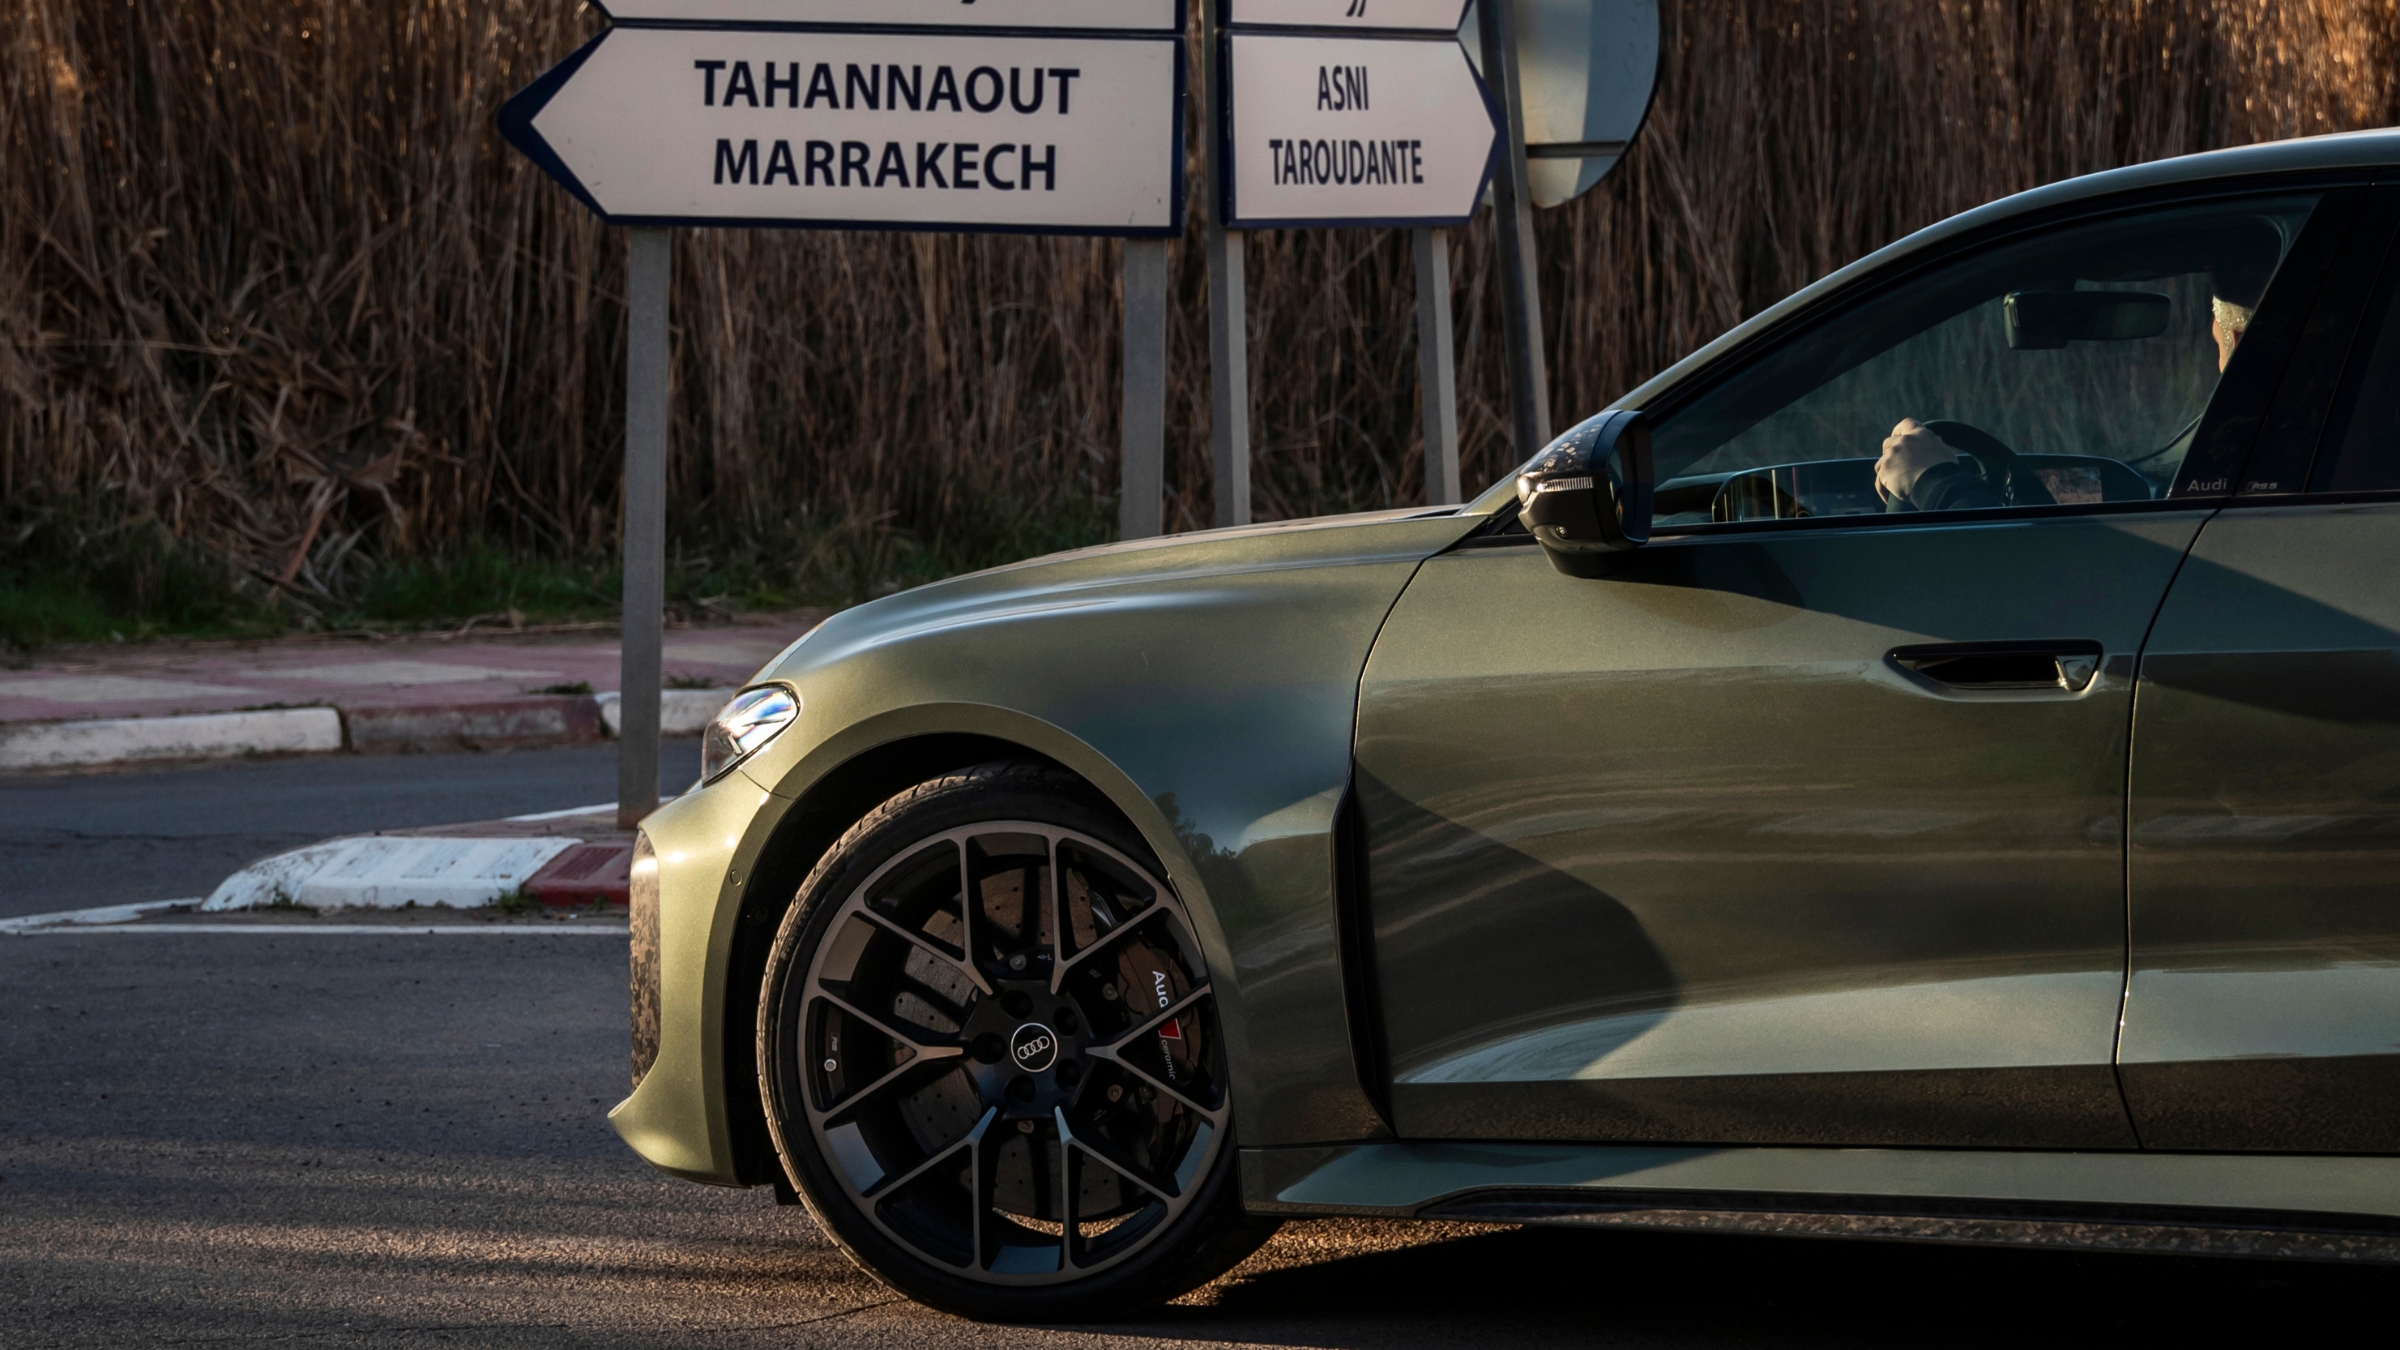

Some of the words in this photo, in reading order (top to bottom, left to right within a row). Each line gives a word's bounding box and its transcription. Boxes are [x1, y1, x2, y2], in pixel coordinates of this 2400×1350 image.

[694, 59, 1080, 115] TAHANNAOUT
[1317, 65, 1369, 111] ASNI
[713, 138, 1057, 191] MARRAKECH
[1269, 139, 1424, 186] TAROUDANTE
[2187, 478, 2227, 492] Audi
[1152, 970, 1169, 1008] Aud
[1161, 1039, 1176, 1079] ceramic
